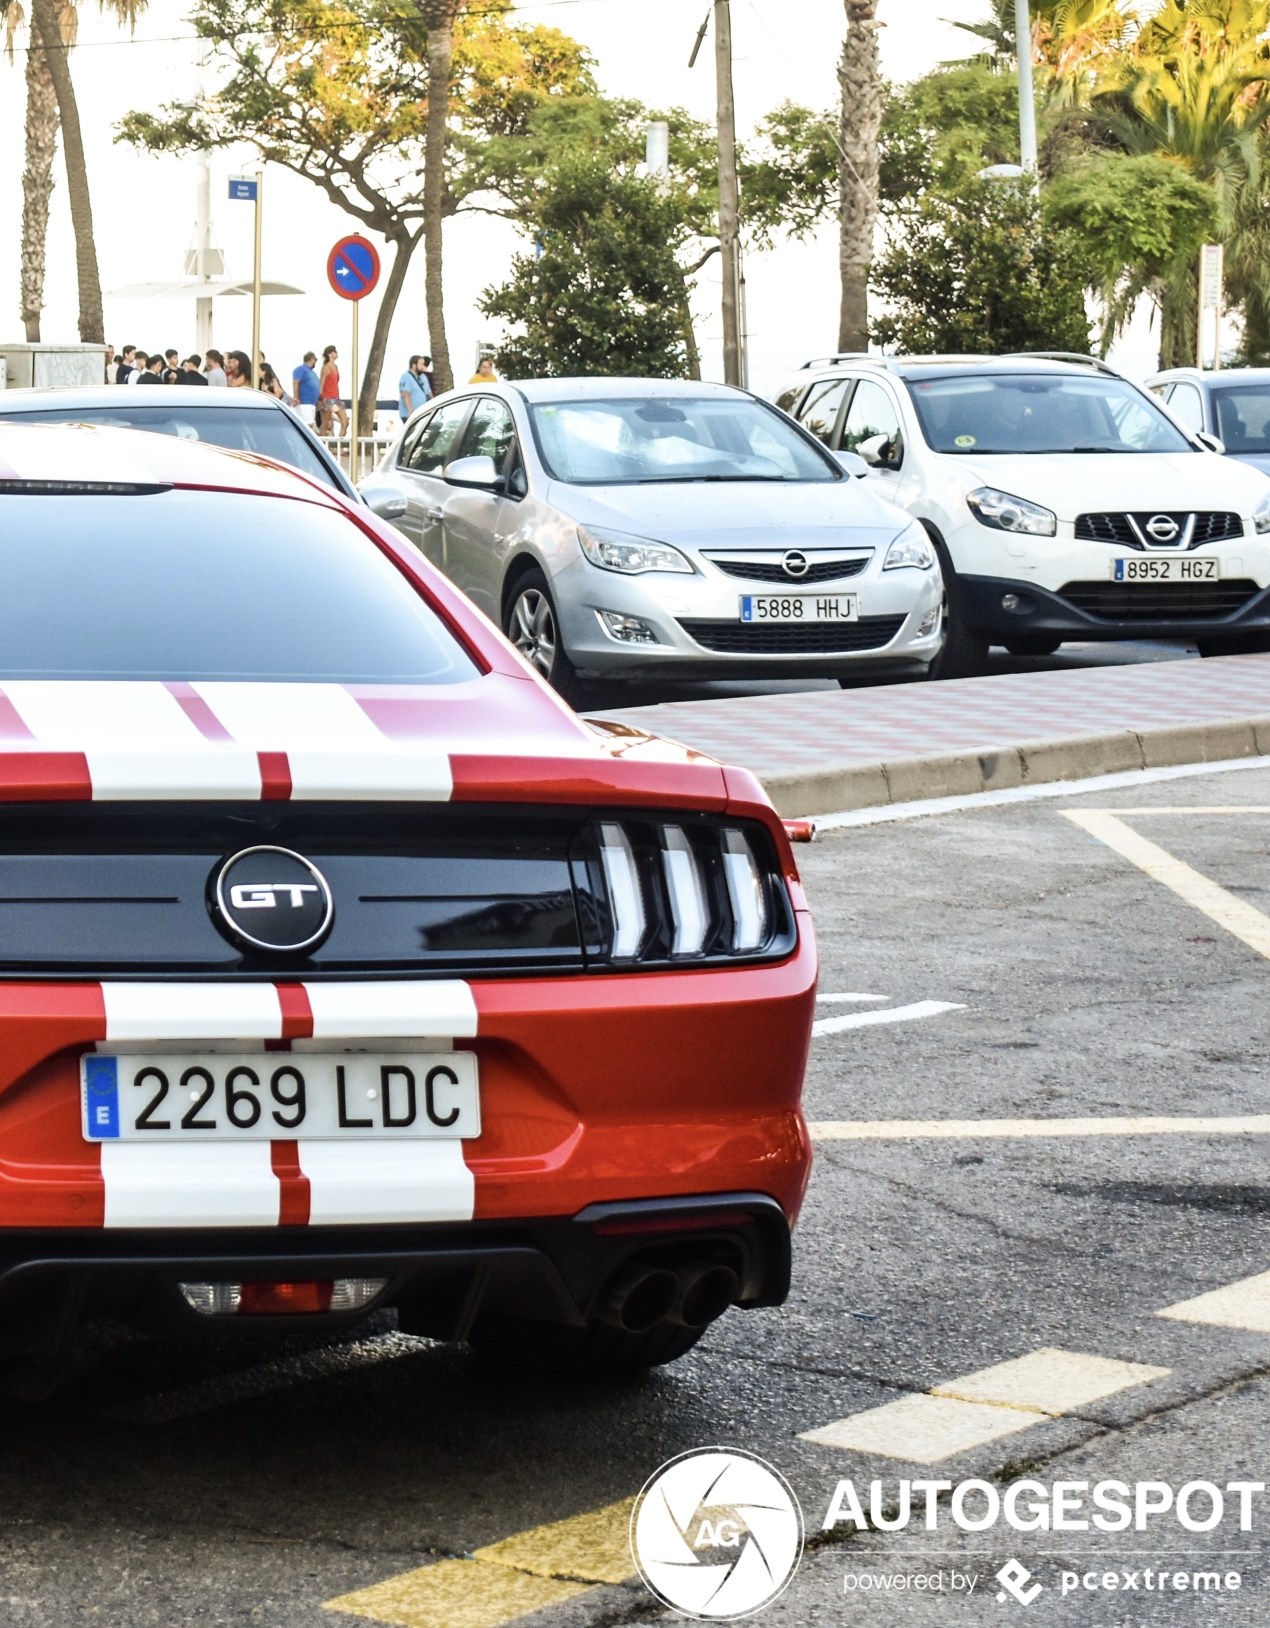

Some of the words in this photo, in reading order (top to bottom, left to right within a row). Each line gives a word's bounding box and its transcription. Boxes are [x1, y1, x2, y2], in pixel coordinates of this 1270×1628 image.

[1127, 561, 1170, 579] 8952
[1180, 561, 1215, 579] HGZ
[756, 598, 804, 618] 5888
[816, 598, 851, 618] HHJ
[230, 884, 318, 909] GT
[96, 1105, 110, 1125] E
[133, 1065, 307, 1130] 2269
[336, 1064, 461, 1128] LDC
